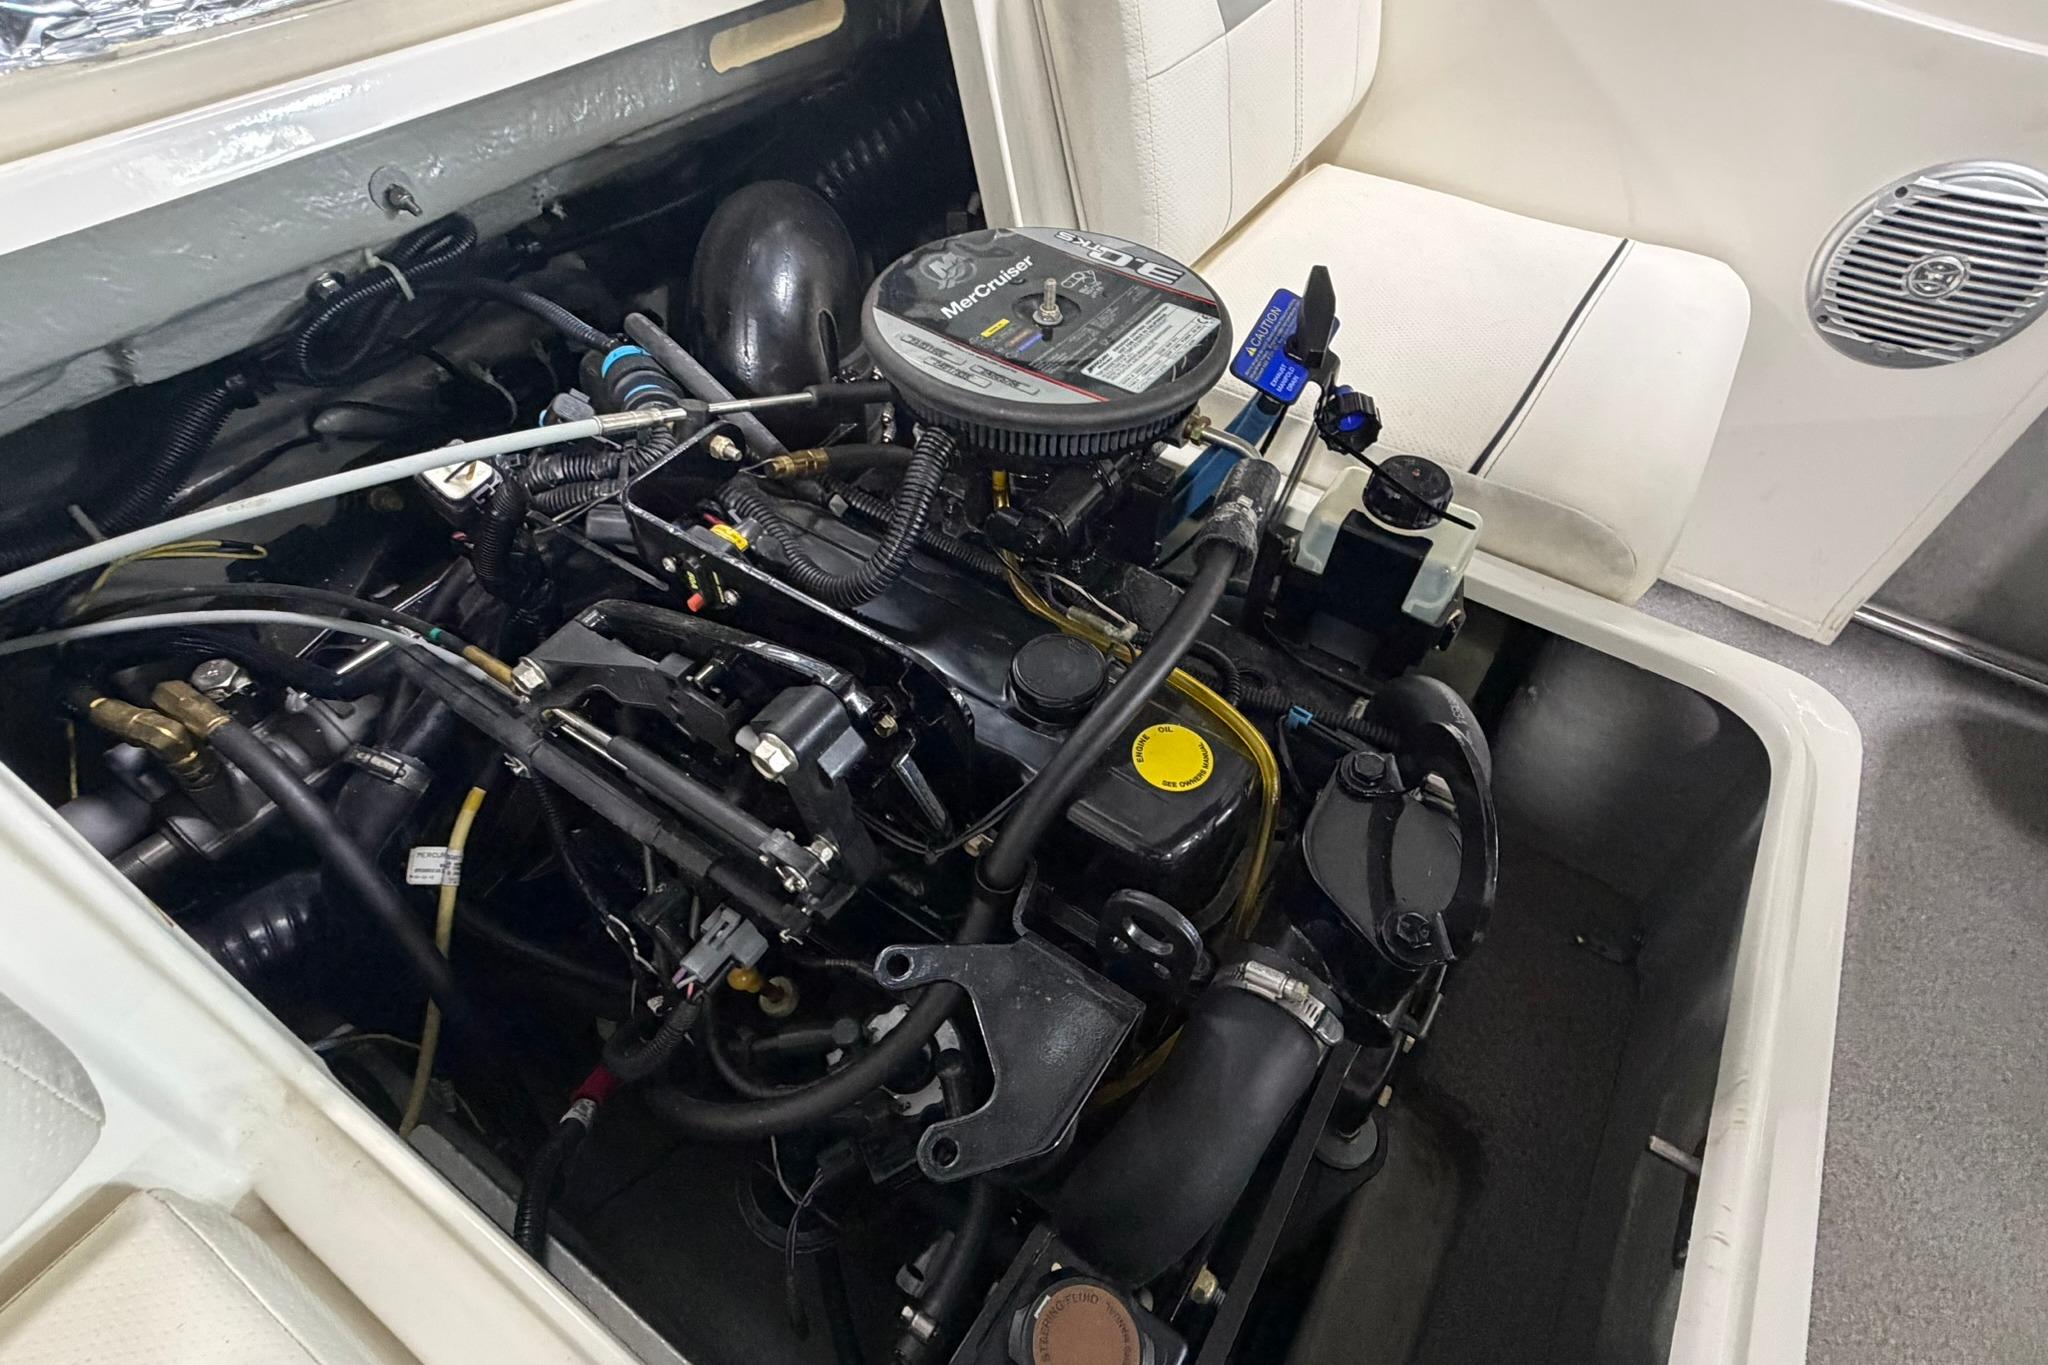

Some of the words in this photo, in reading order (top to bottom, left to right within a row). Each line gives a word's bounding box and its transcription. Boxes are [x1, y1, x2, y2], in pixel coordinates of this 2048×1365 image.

[1055, 230, 1105, 253] TKS
[1088, 249, 1185, 285] 3.0
[940, 255, 1033, 319] MerCruiser
[1250, 306, 1282, 347] CAUTION
[1276, 366, 1296, 392] MANIFOLD
[1135, 733, 1151, 763] ENGINE
[1161, 780, 1178, 788] SEE
[1179, 769, 1207, 788] OWNERS
[1198, 742, 1210, 770] MANUAL
[1040, 1299, 1066, 1362] STEERING
[1066, 1292, 1100, 1305] FLUID
